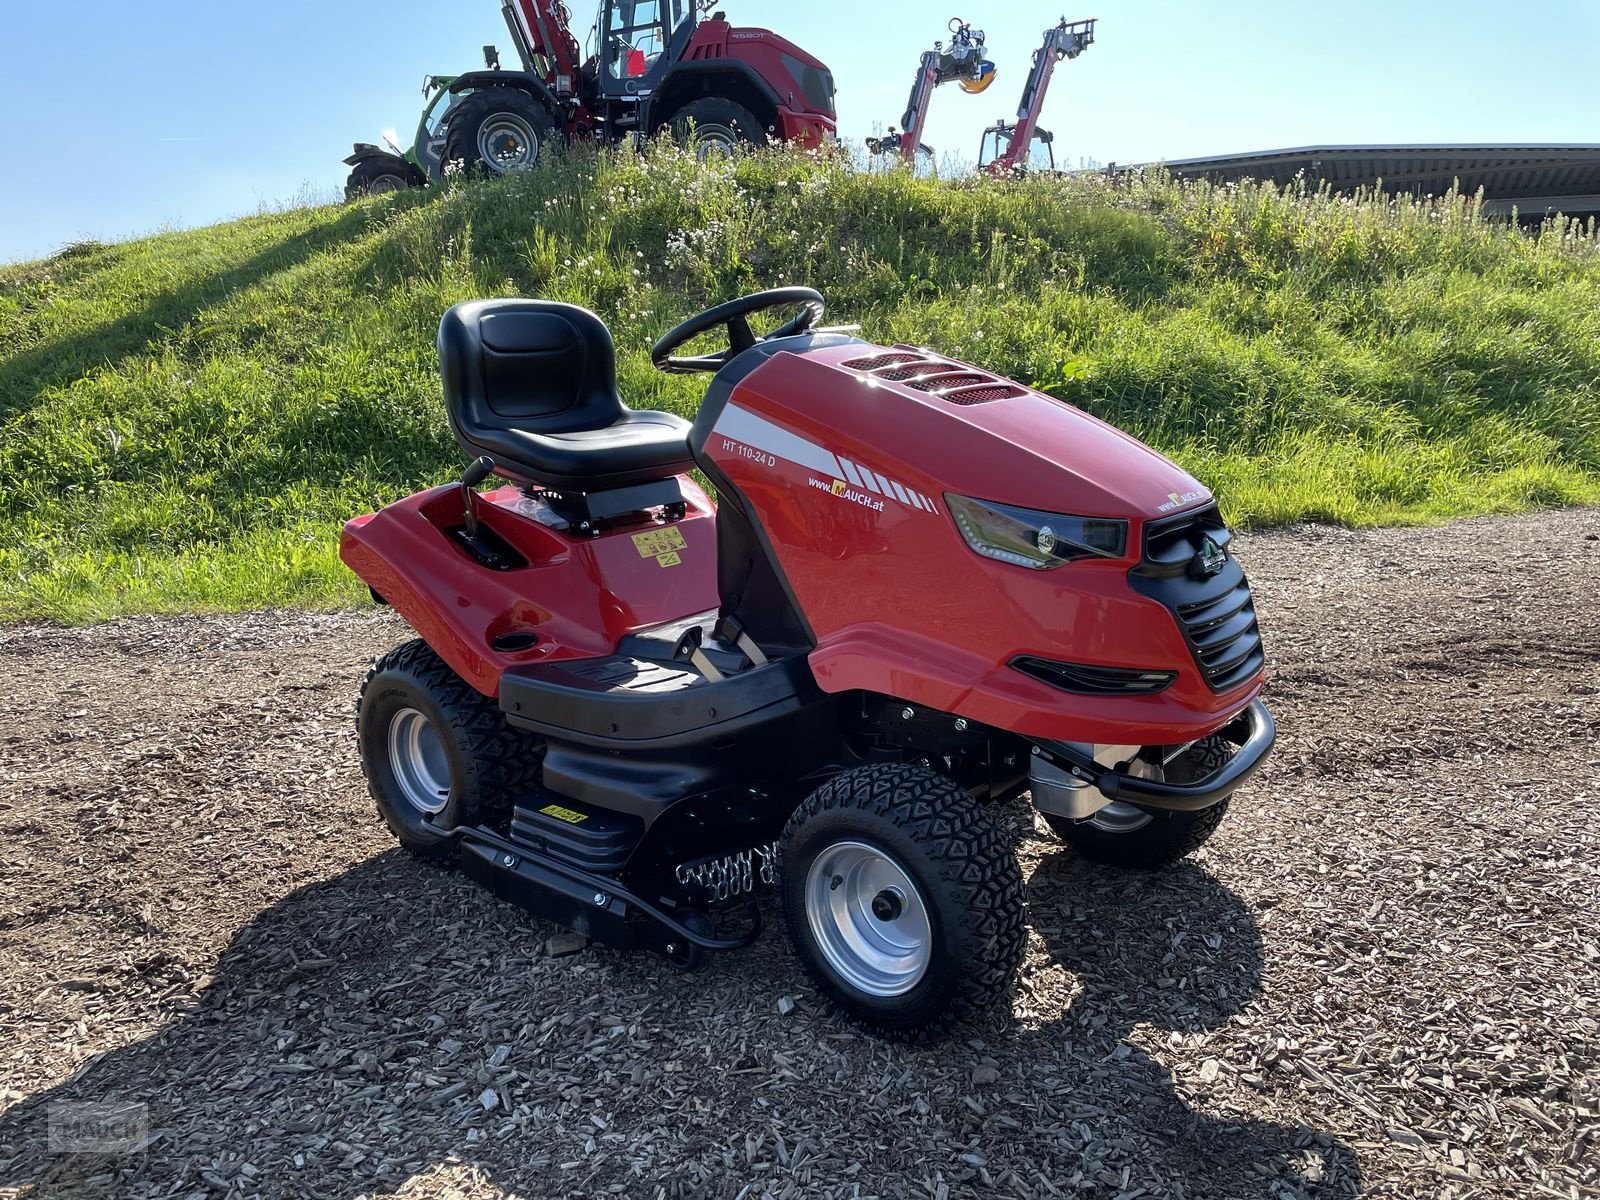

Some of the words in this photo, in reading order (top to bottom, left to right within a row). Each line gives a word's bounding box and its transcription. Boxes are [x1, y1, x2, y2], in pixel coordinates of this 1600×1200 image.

[722, 439, 737, 452] HT
[738, 445, 767, 465] 110-24
[767, 455, 776, 467] D
[808, 477, 884, 512] www.MAUCH.at
